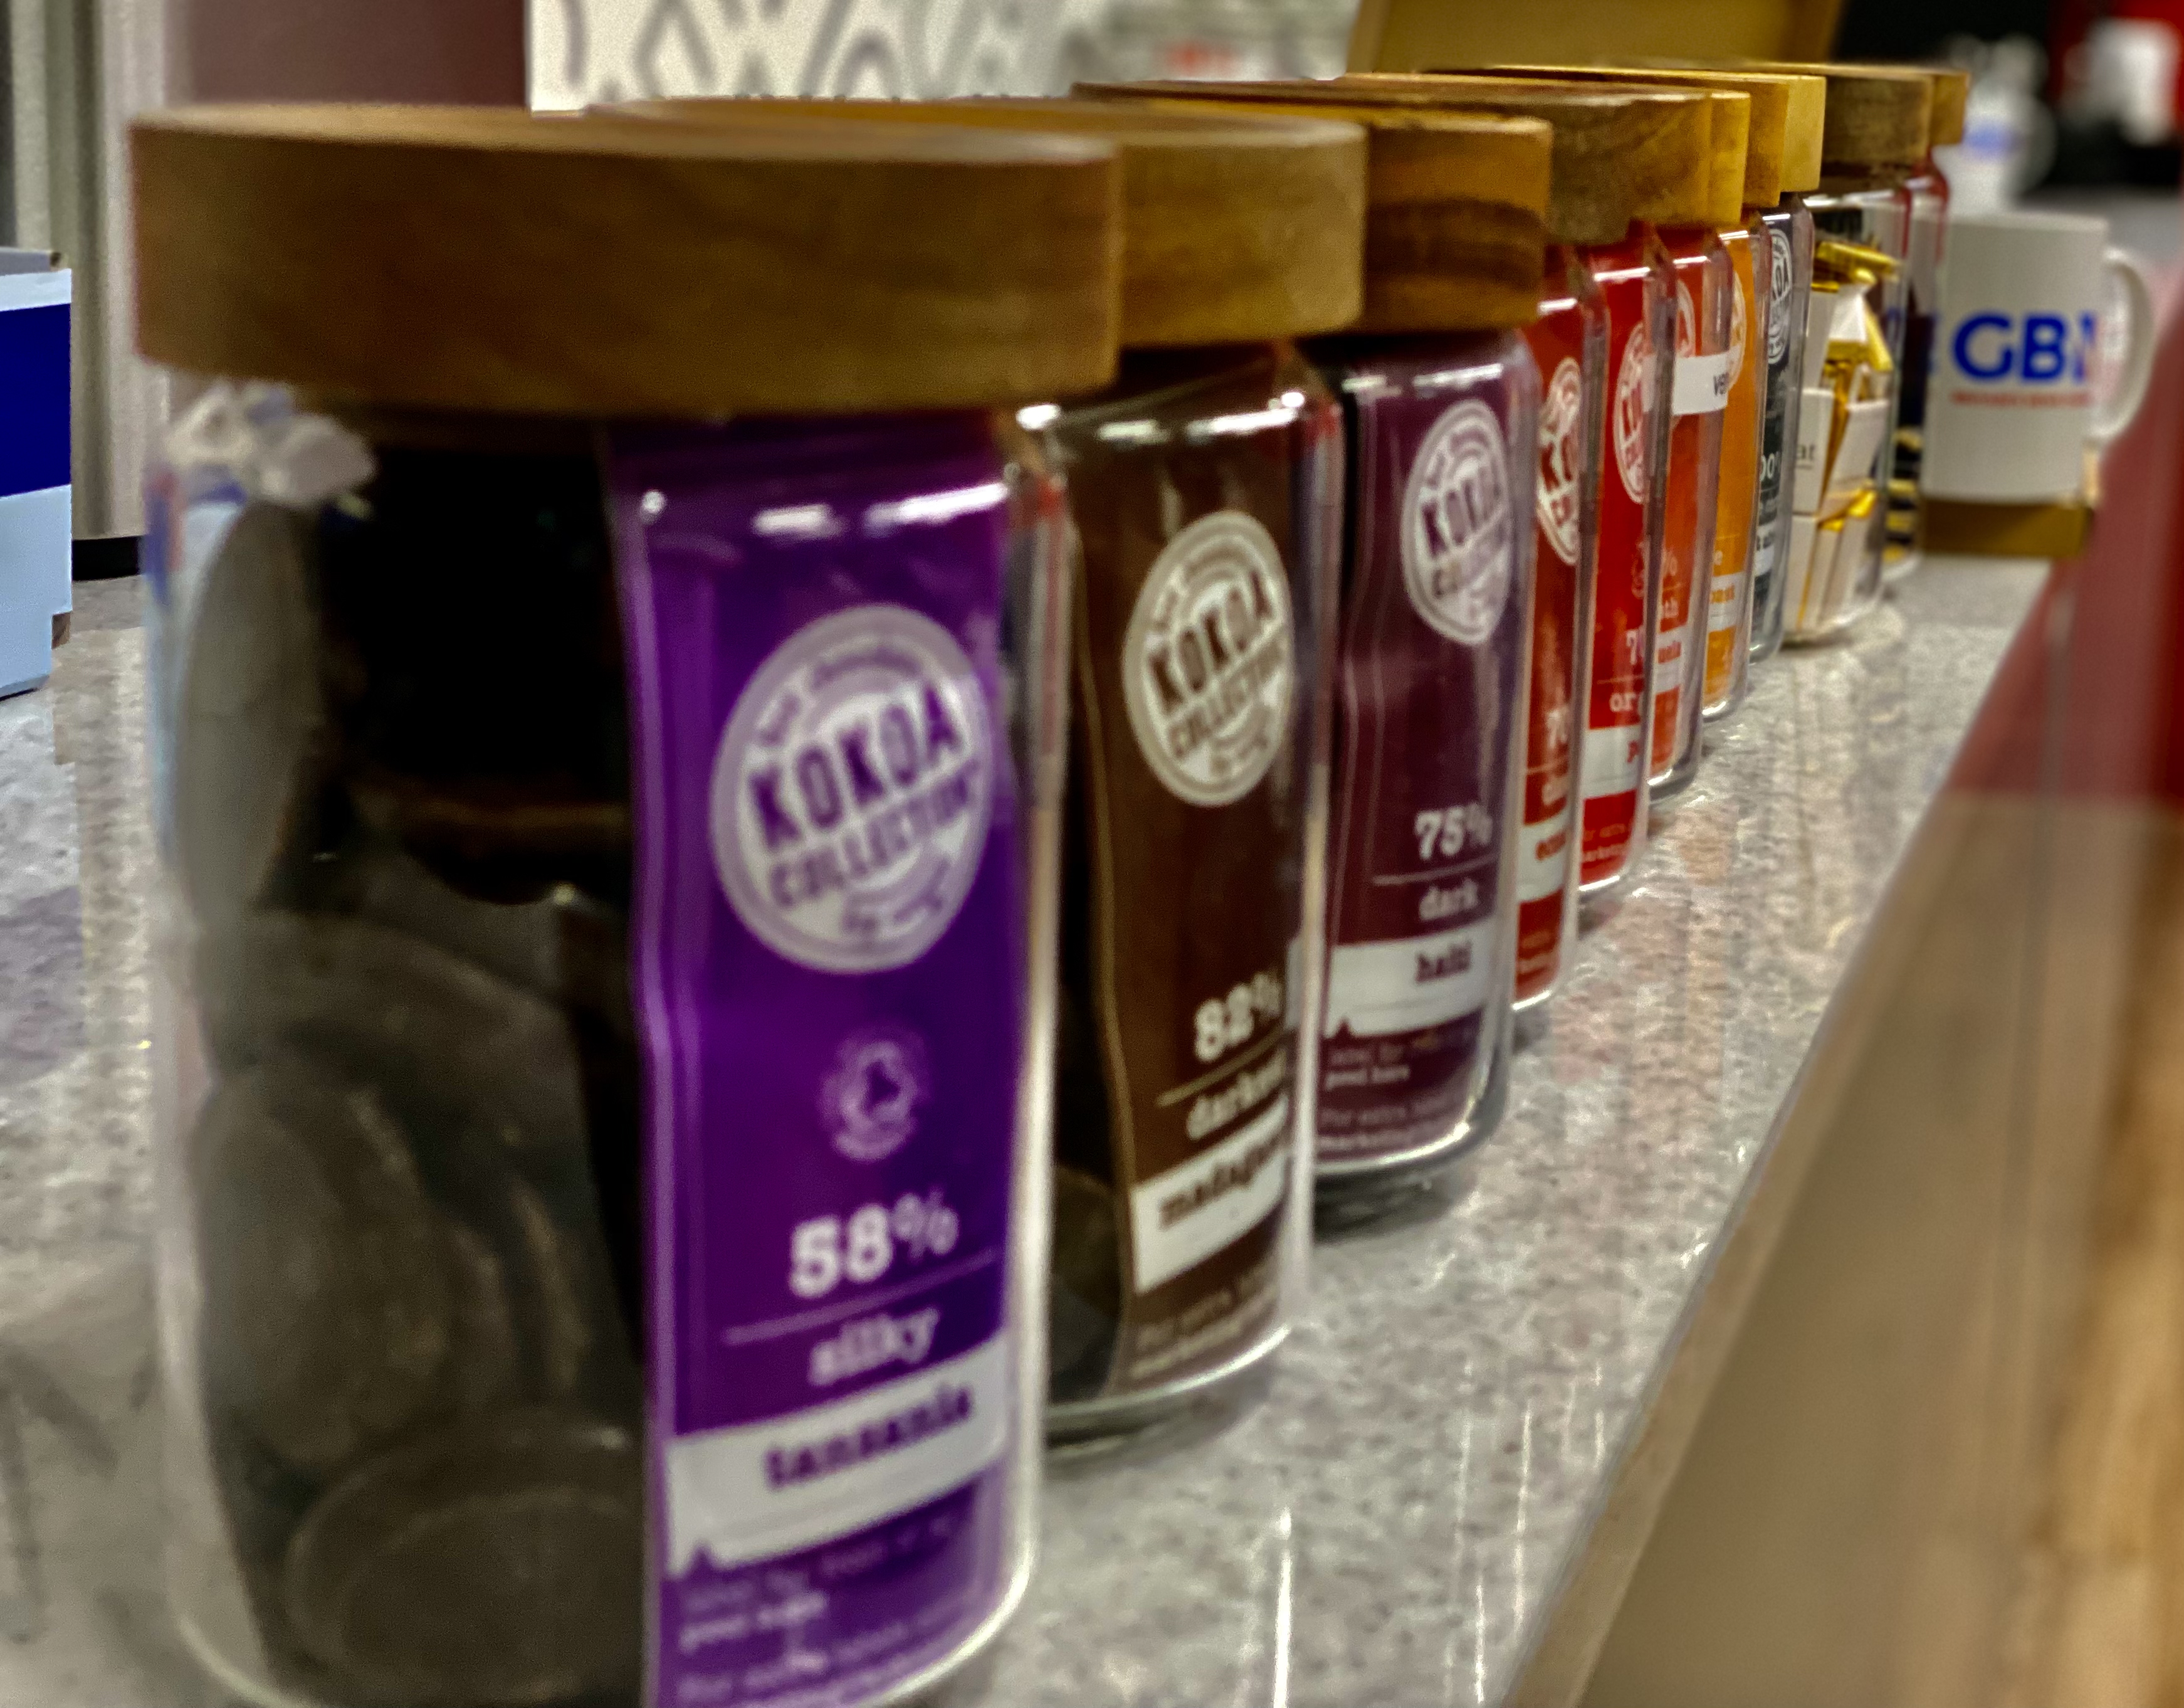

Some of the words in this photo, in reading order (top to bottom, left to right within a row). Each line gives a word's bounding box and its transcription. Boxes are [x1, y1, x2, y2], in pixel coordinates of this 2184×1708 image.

[1148, 567, 1277, 718] KOKOA
[749, 683, 965, 851] KOKOA
[1413, 801, 1494, 860] 75%
[1417, 878, 1480, 924] dark
[787, 1185, 961, 1299] 58%
[807, 1305, 940, 1386] silky
